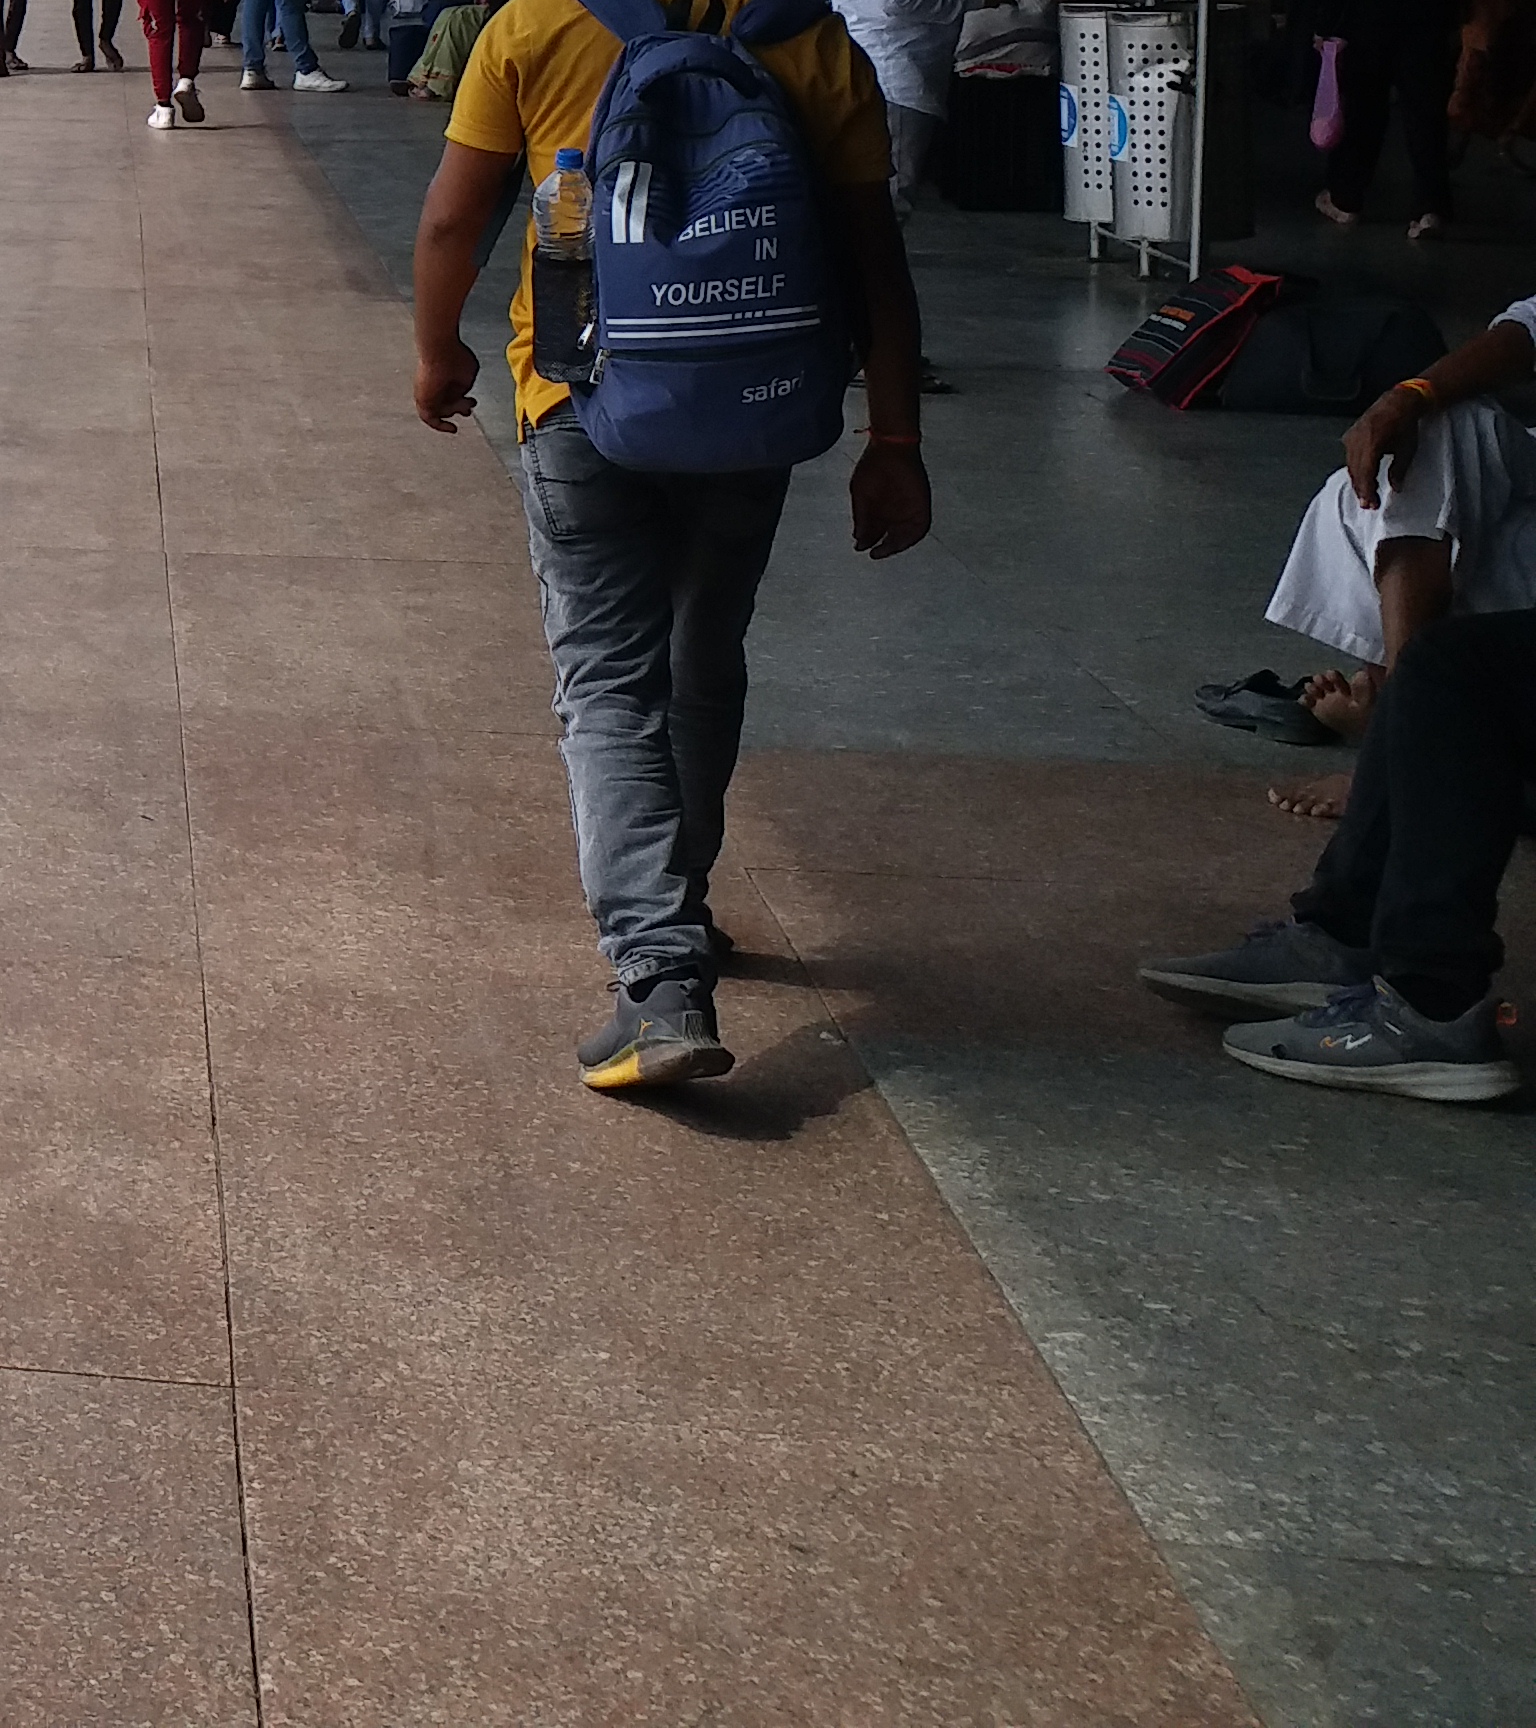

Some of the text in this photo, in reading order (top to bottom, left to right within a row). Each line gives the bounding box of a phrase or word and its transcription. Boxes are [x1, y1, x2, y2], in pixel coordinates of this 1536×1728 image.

[678, 205, 777, 242] BELIEVE
[754, 237, 778, 261] IN
[651, 274, 786, 306] YOURSELF
